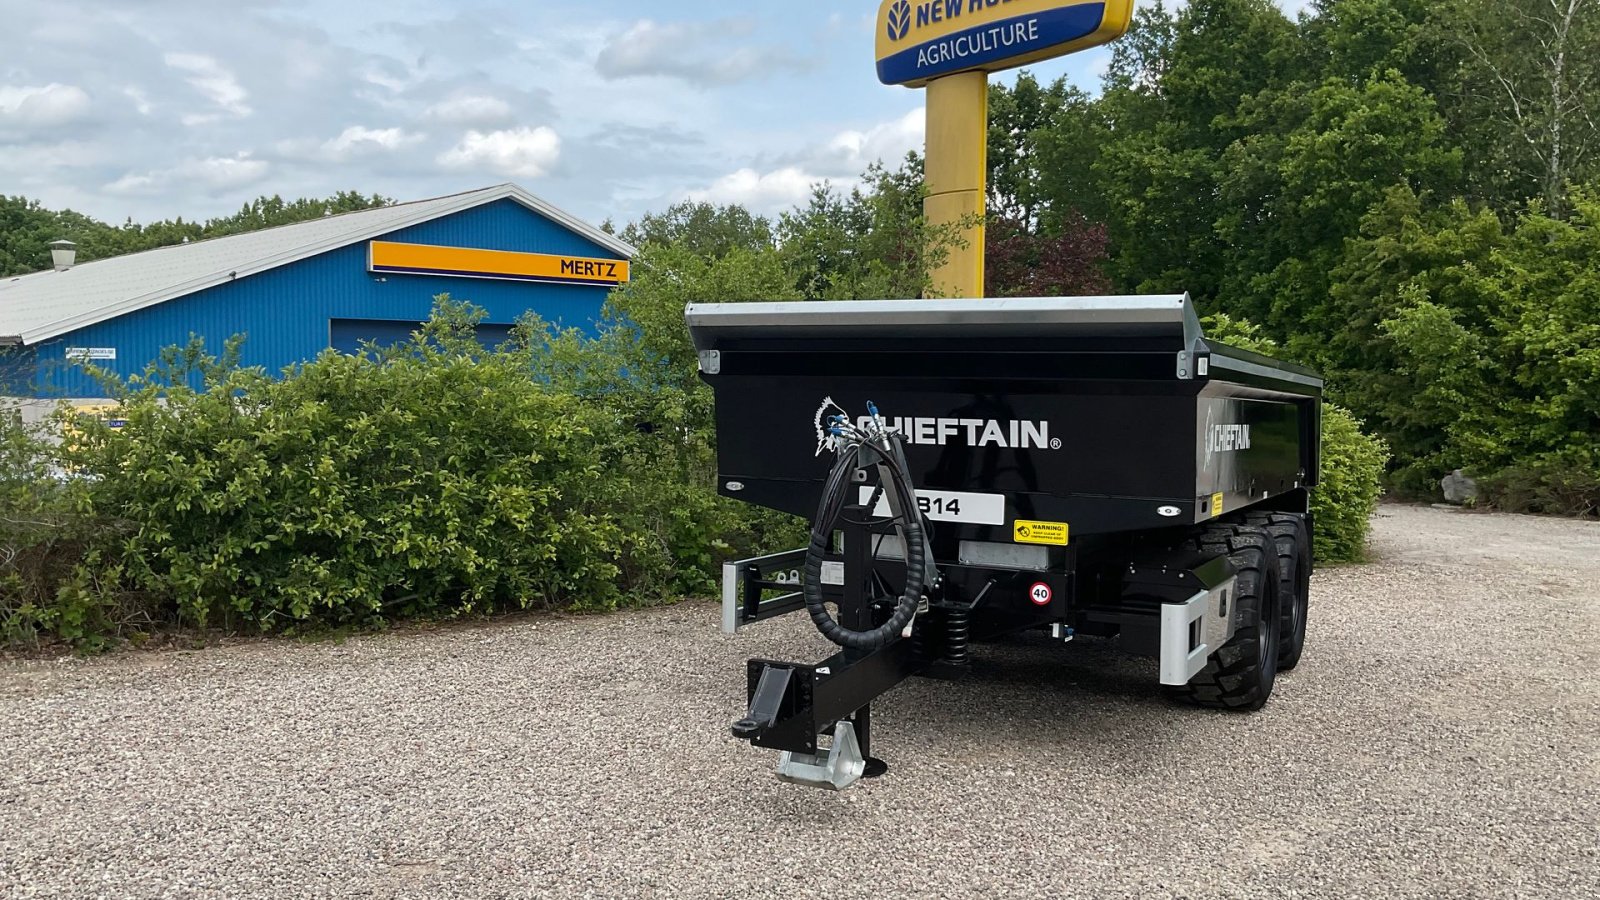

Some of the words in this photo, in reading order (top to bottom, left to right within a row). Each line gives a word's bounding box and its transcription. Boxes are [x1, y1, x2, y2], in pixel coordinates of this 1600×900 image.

[916, 0, 962, 28] NEW
[916, 19, 1039, 68] AGRICULTURE
[560, 259, 617, 277] MERTZ
[1033, 588, 1048, 599] 40
